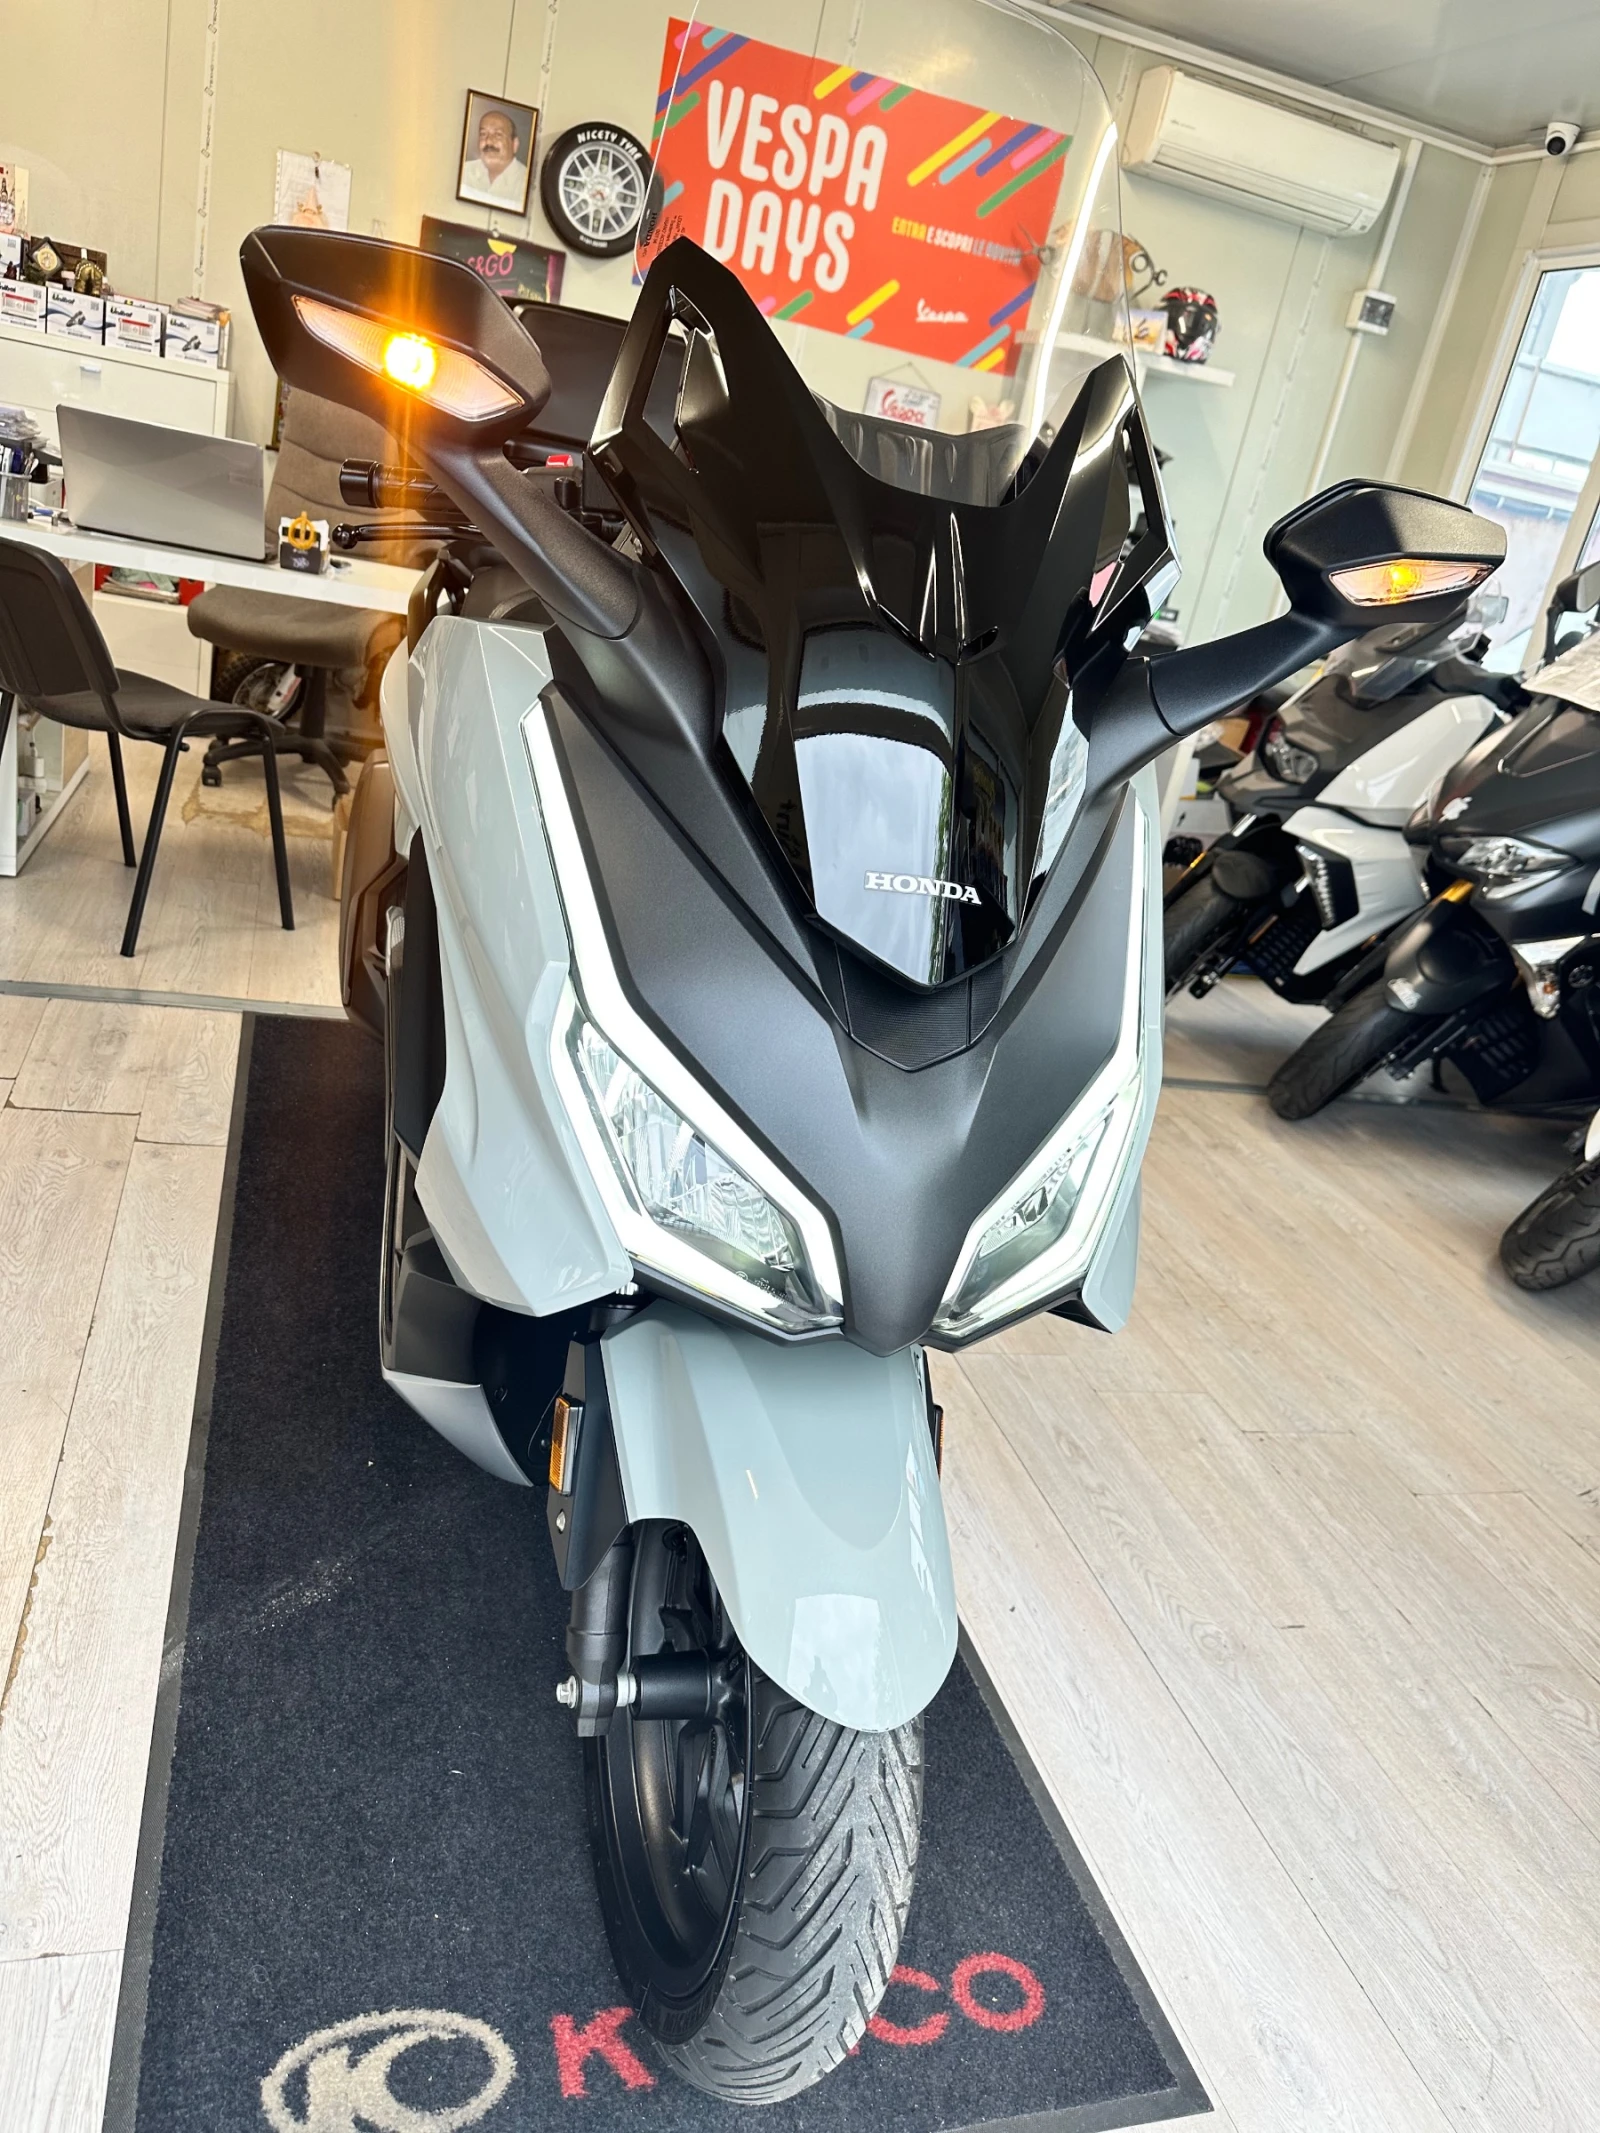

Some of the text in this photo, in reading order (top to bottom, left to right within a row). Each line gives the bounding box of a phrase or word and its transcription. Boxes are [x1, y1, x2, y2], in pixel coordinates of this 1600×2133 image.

[577, 130, 642, 160] NICETY TYRE
[708, 80, 888, 211] VESPA
[644, 212, 657, 247] HONDA
[703, 178, 855, 293] DAYS
[892, 216, 927, 242] ENTRA
[934, 228, 974, 254] SCOPRI
[878, 388, 926, 425] Vespa
[864, 872, 982, 905] HONDA
[550, 1951, 1045, 2099] KCO
